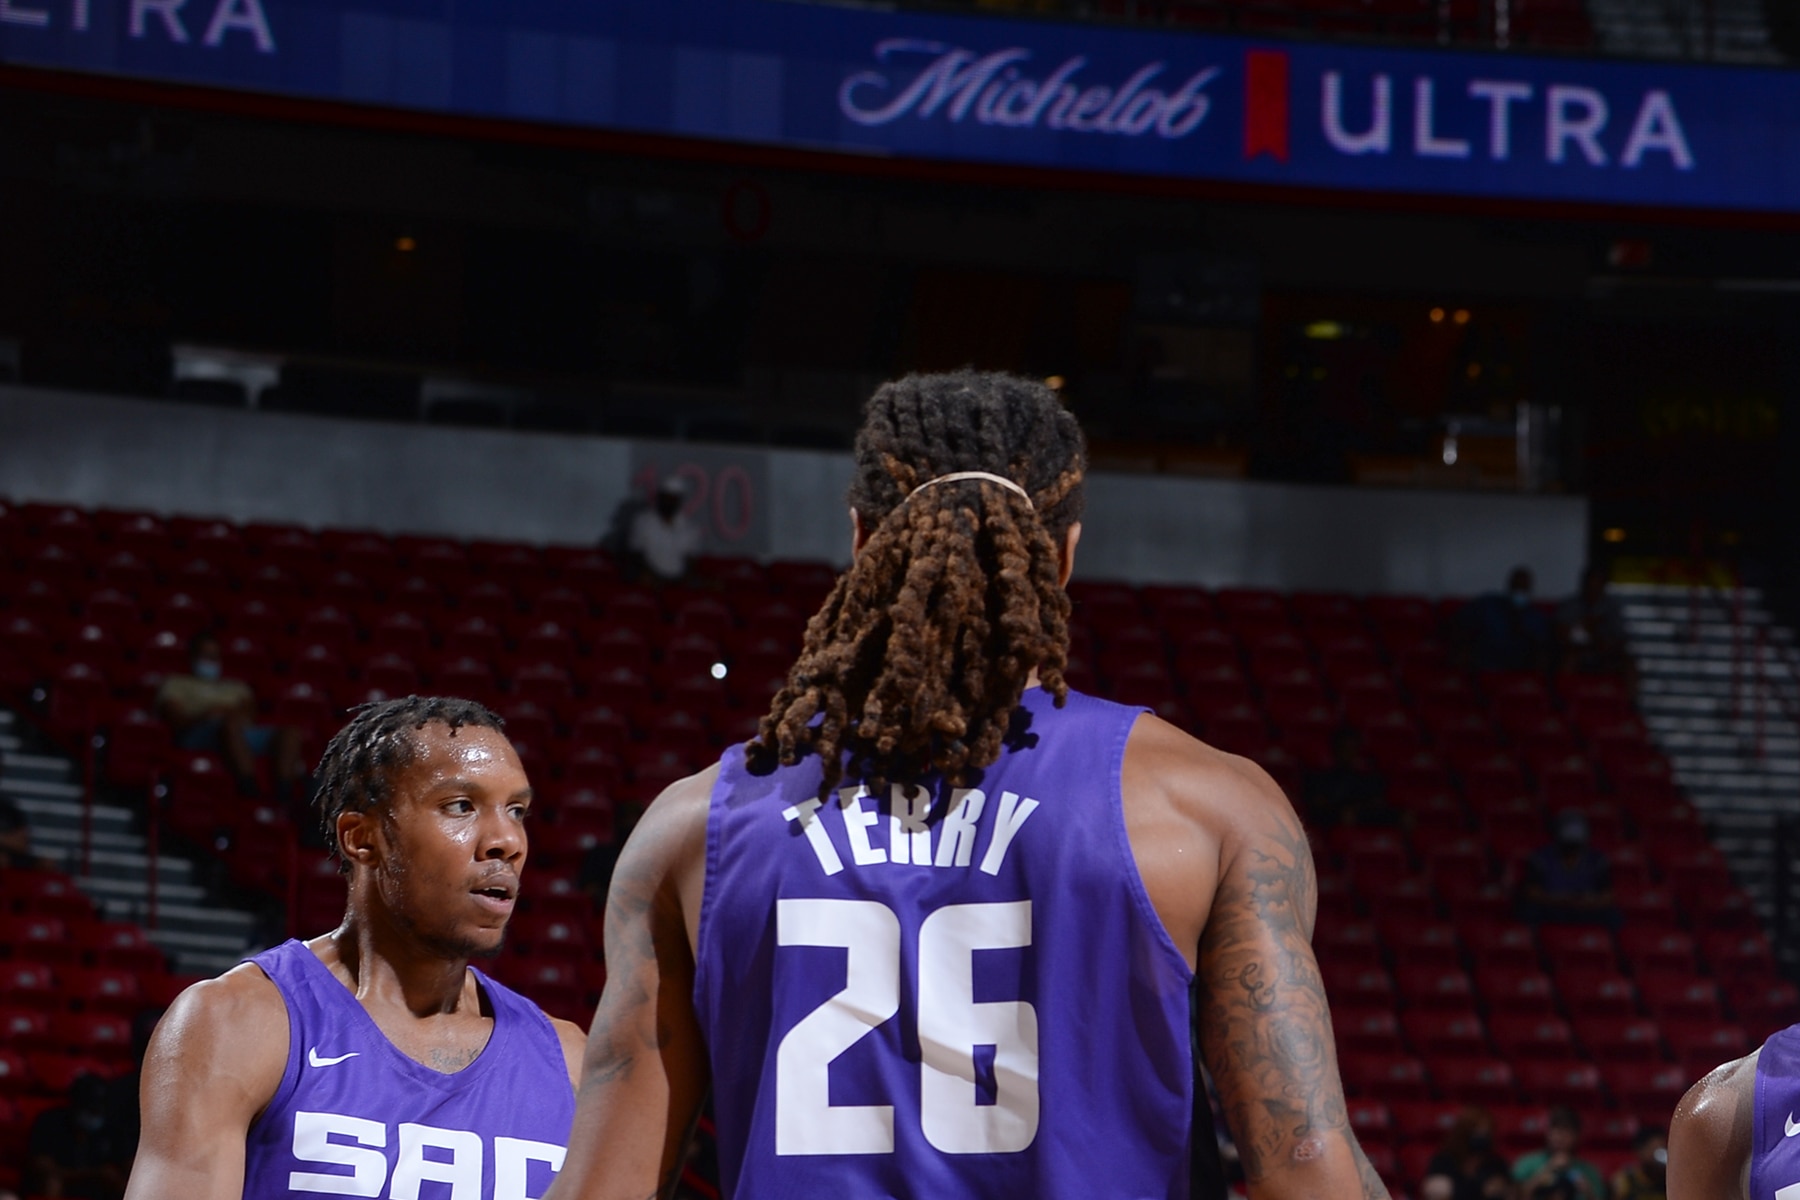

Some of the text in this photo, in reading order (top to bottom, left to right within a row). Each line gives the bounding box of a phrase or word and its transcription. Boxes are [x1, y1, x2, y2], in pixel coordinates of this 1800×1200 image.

[838, 37, 1693, 169] Michelob ULTRA
[782, 783, 1040, 876] TERRY
[776, 898, 1039, 1156] 26
